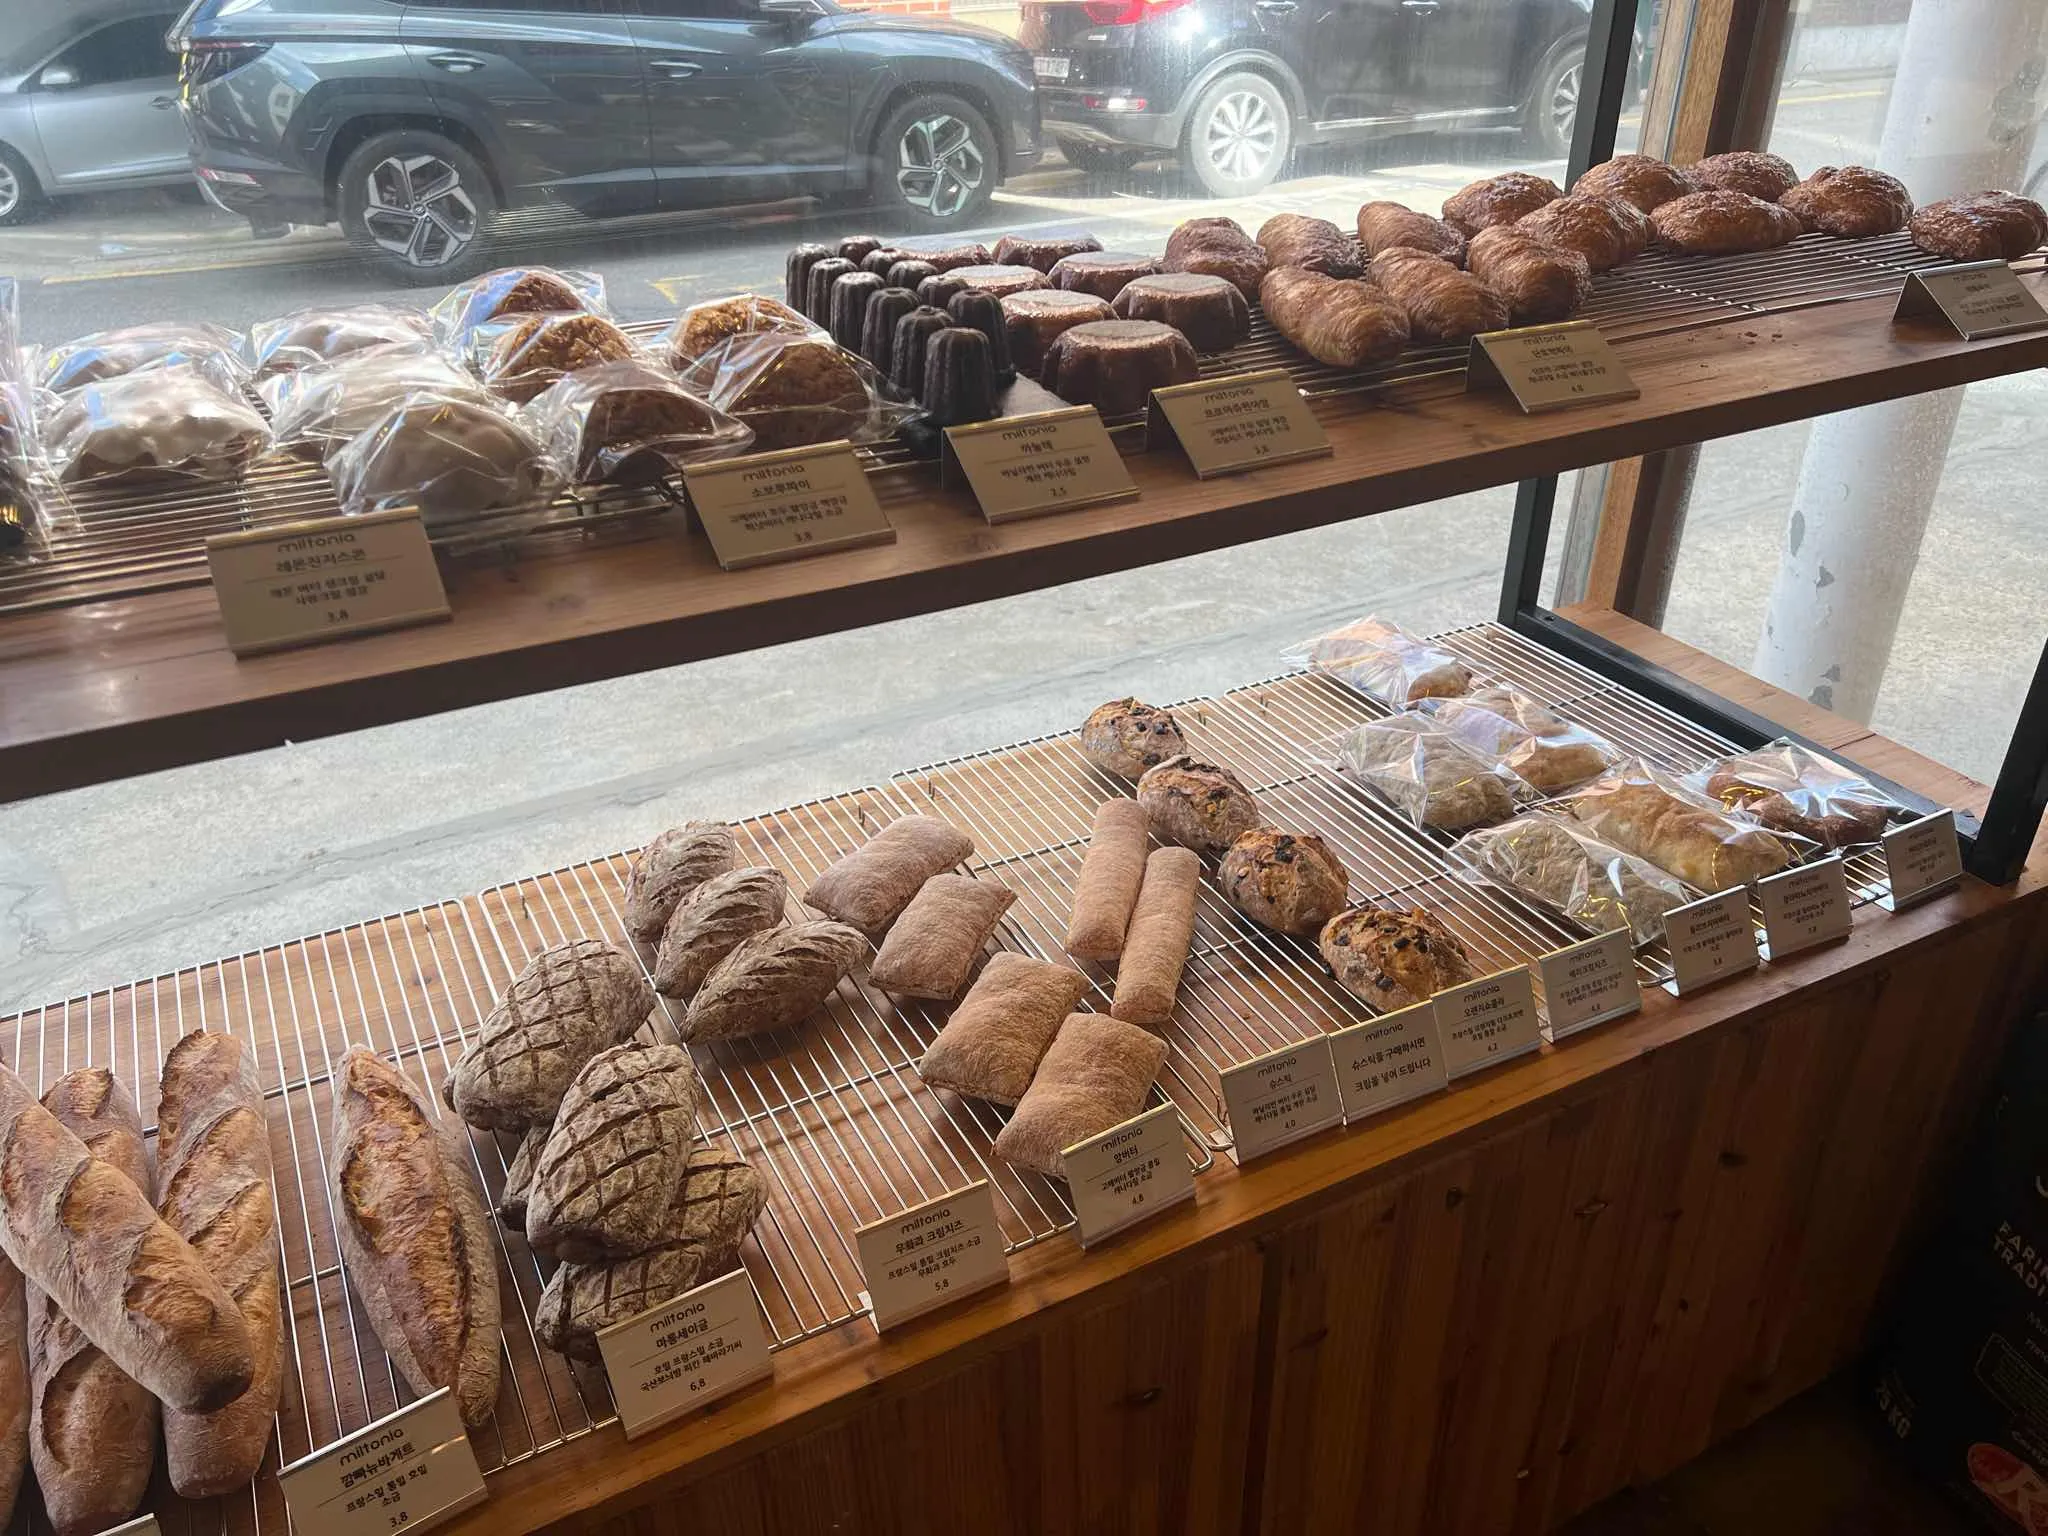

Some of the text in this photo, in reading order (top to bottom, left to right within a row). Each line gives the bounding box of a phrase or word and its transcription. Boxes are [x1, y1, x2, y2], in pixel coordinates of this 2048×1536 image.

[1002, 425, 1057, 440] miltonia
[743, 465, 805, 481] miltonia
[278, 532, 355, 552] miltonia
[1464, 985, 1500, 1002] miltonia
[1365, 1023, 1404, 1042] miltonia
[1257, 1057, 1297, 1078] miltonia
[1399, 1057, 1431, 1076] 드립니다
[1101, 1128, 1143, 1152] miltonia
[1113, 1145, 1138, 1163] 앙버터
[901, 1209, 951, 1234] miltonia
[896, 1220, 964, 1253] 무화과 크림치즈
[888, 1262, 917, 1280] 프랑스밀
[936, 1243, 964, 1260] 크림치즈
[966, 1235, 981, 1248] 소금
[935, 1278, 949, 1291] 5.8
[650, 1303, 705, 1333] miltonia
[673, 1345, 705, 1366] 프랑스밀
[707, 1337, 724, 1351] 소금
[340, 1429, 404, 1466] miltonia
[341, 1443, 415, 1488] 깜빠뉴바게트
[347, 1486, 384, 1512] 프랑스밀
[387, 1475, 406, 1491] 통밀
[382, 1491, 401, 1506] 소금
[389, 1511, 408, 1528] 3.8
